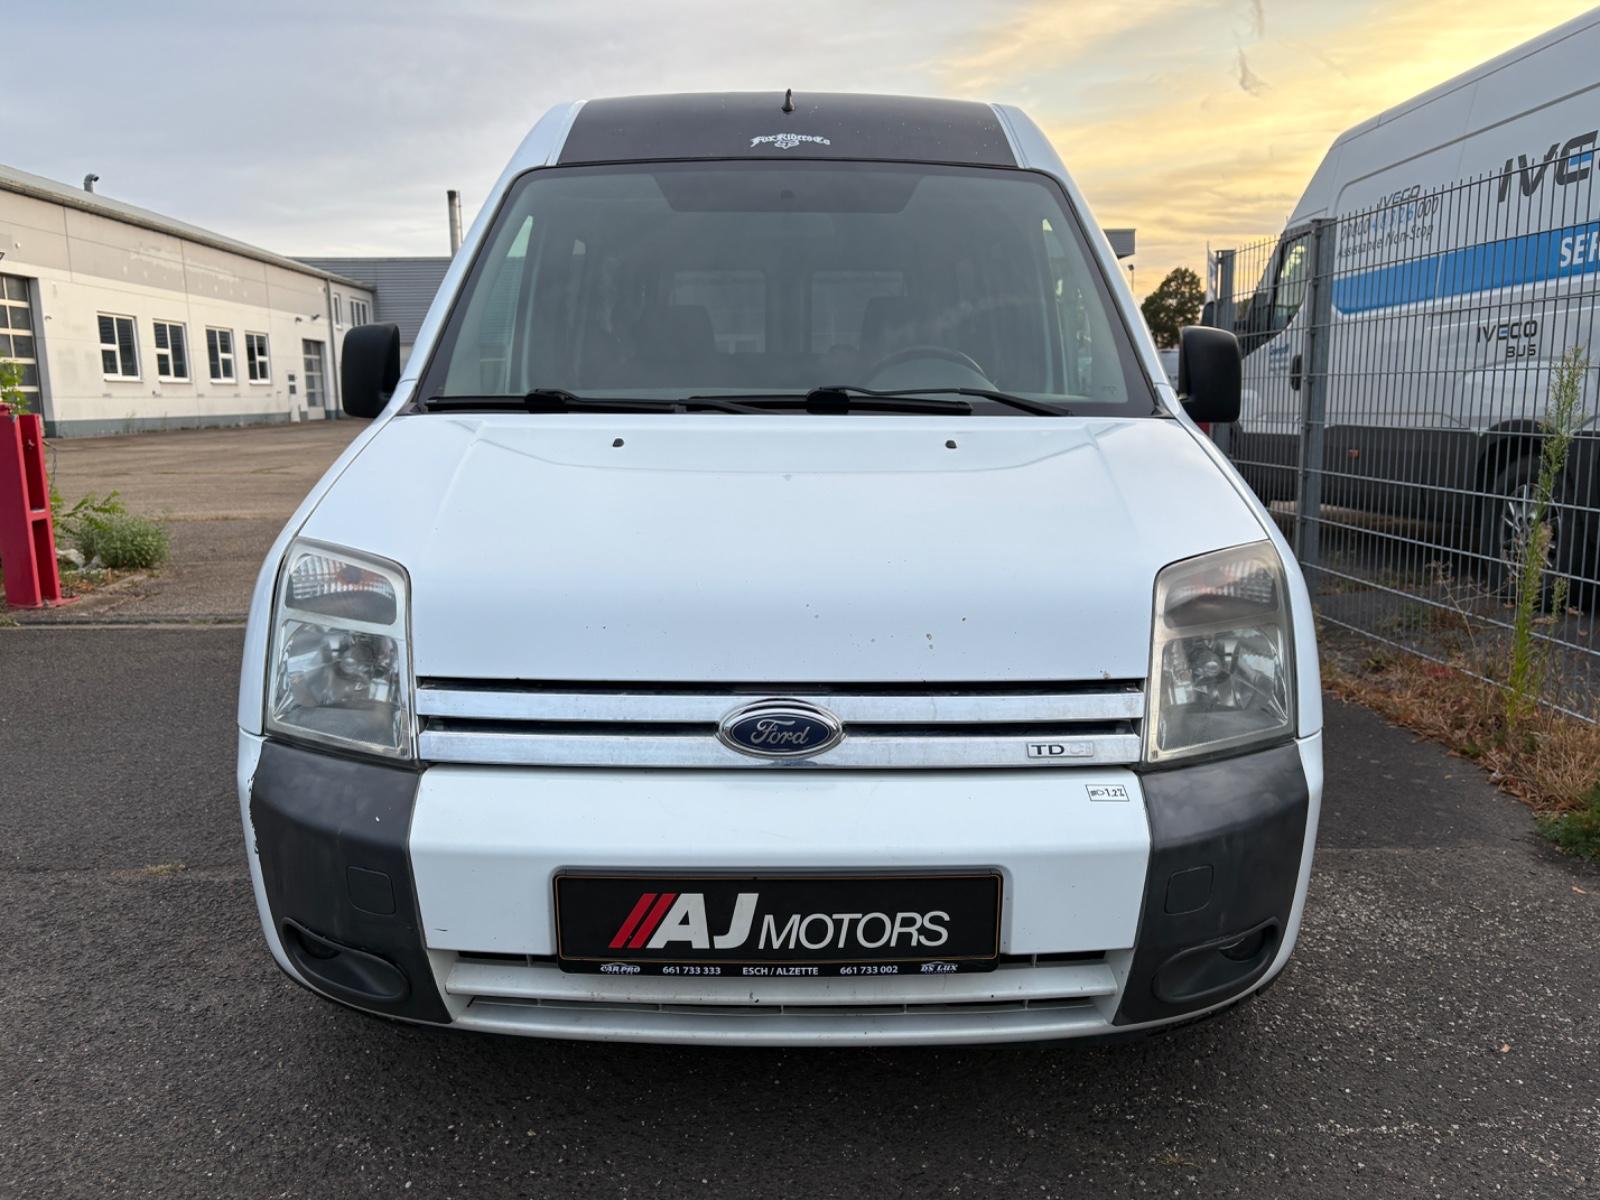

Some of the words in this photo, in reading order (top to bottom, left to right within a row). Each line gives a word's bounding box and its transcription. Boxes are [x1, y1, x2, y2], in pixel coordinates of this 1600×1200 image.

[1499, 130, 1600, 203] IVE
[1477, 320, 1538, 343] IVECO
[1506, 343, 1536, 358] BUS
[750, 719, 811, 744] Ford
[646, 893, 759, 949] AJ
[758, 910, 950, 950] MOTORS
[600, 965, 619, 974] CAR
[662, 966, 680, 974] 661
[683, 966, 701, 975] 733
[703, 966, 721, 975] 333
[742, 967, 769, 976] ESCH
[776, 967, 819, 976] ALZETTE
[840, 966, 857, 975] 661
[860, 966, 878, 974] 733
[880, 966, 898, 974] 002
